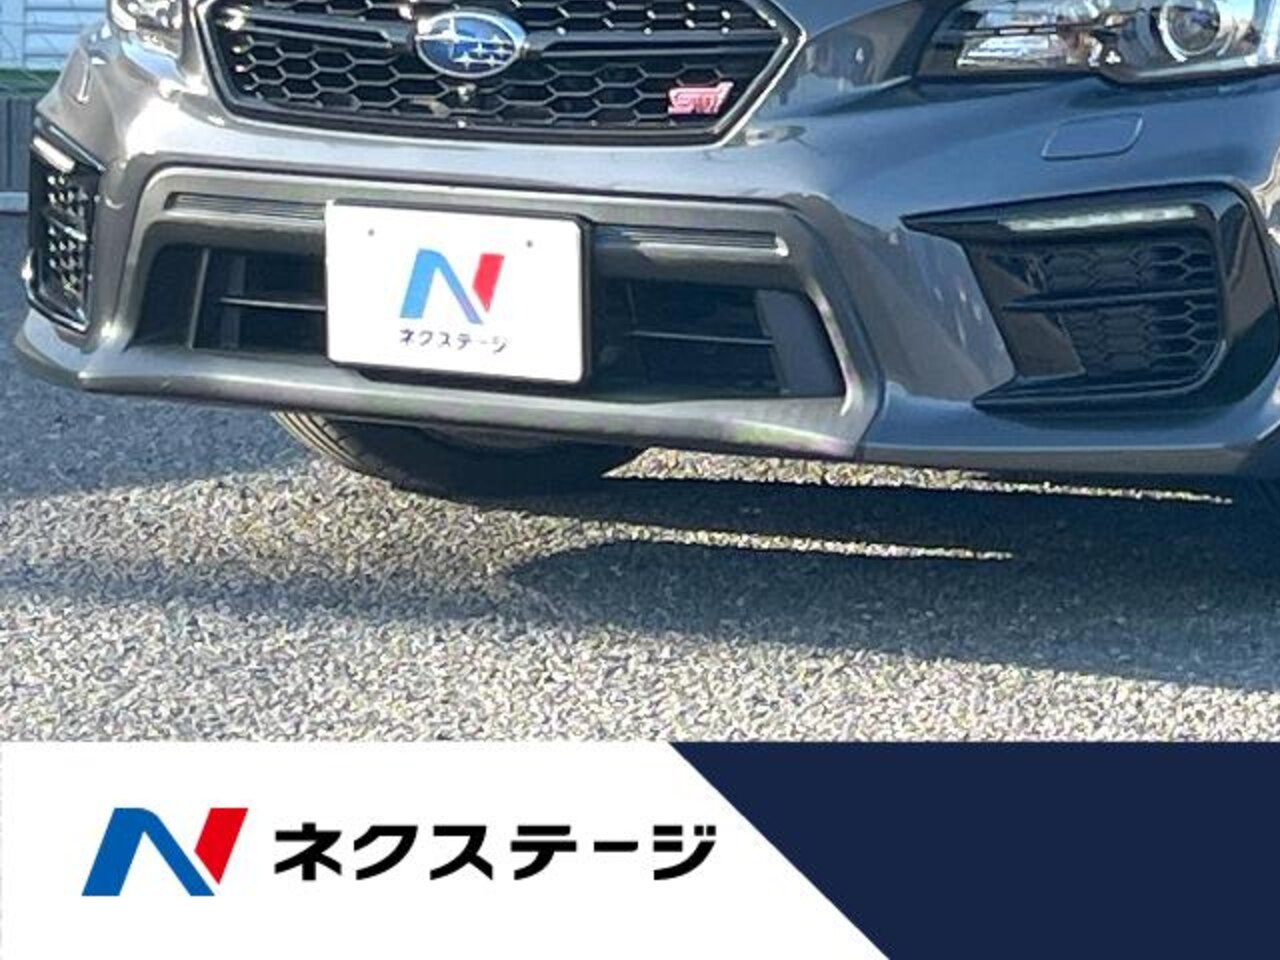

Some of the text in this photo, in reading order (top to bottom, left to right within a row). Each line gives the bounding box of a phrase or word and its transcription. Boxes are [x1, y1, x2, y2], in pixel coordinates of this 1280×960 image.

[399, 329, 509, 355] ネクステージ
